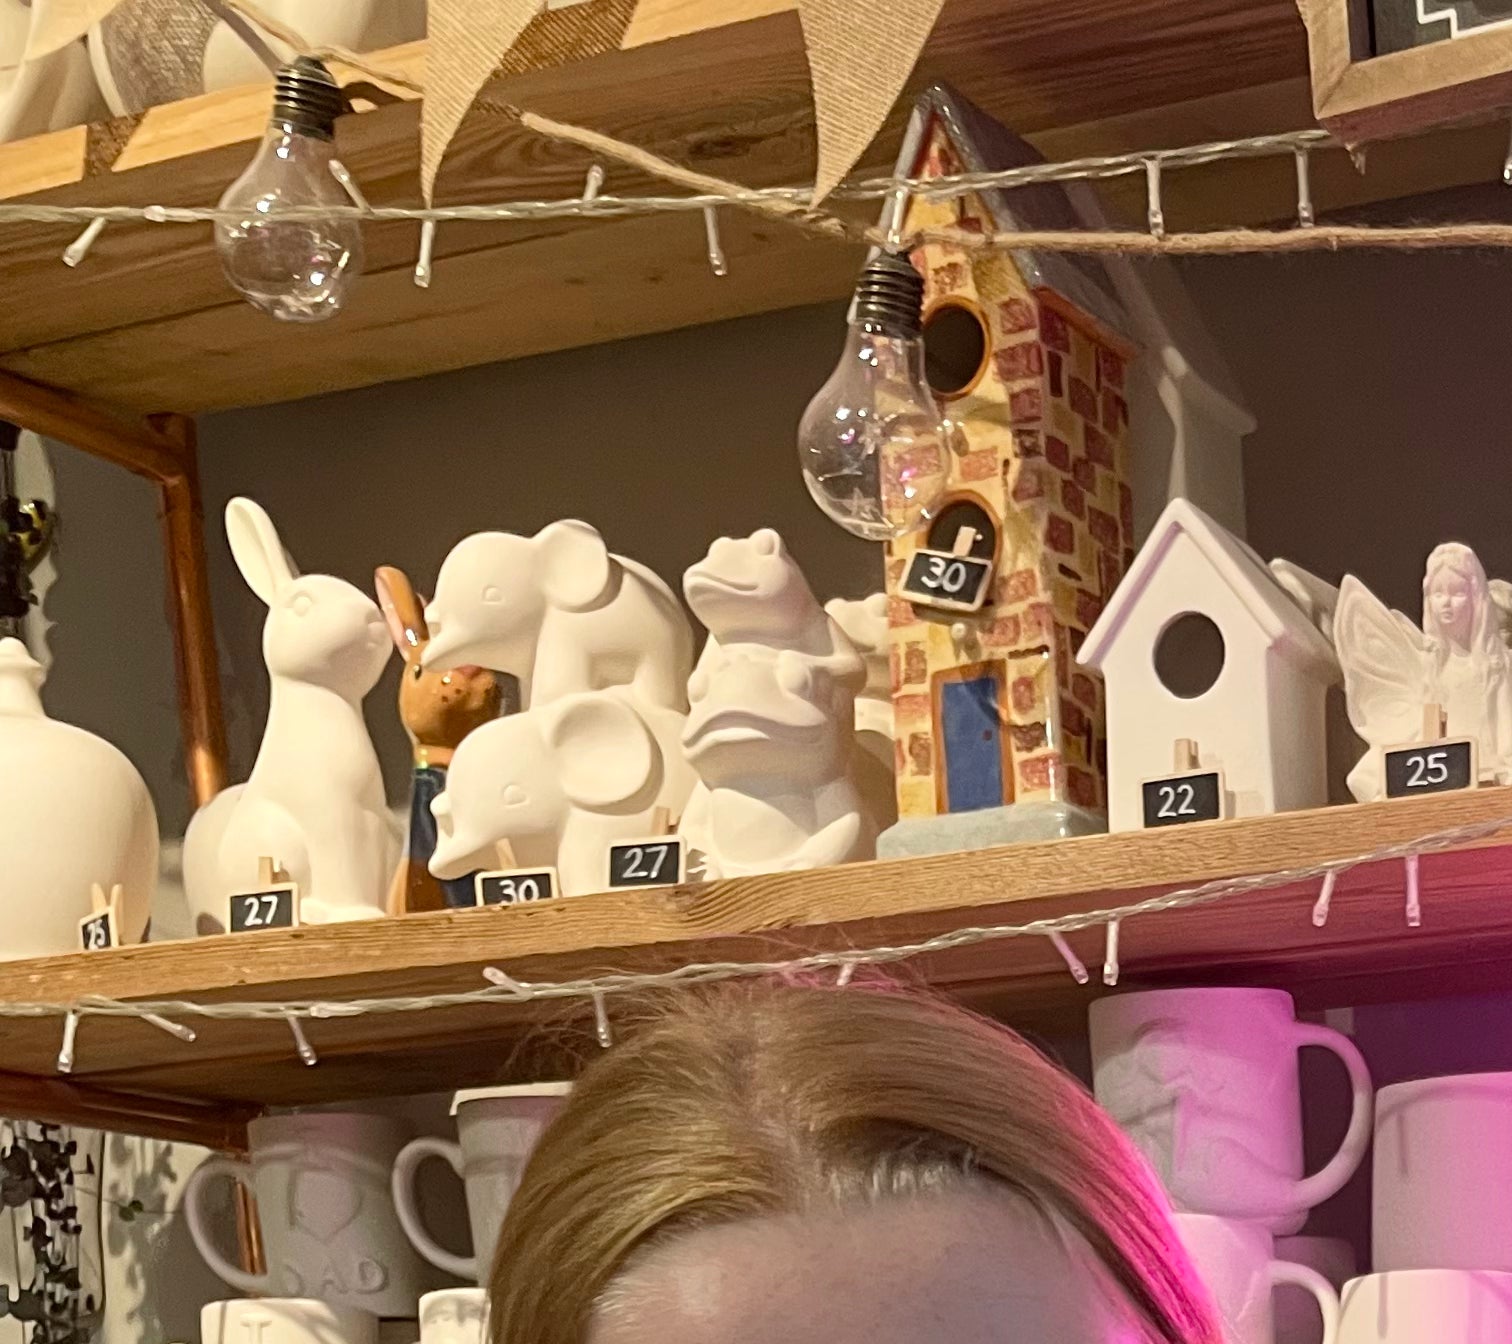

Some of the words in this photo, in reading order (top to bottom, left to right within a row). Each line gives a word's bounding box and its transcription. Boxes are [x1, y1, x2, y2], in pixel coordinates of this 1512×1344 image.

[921, 557, 967, 593] 30
[1405, 752, 1448, 788] 25
[1157, 783, 1197, 818] 22
[621, 845, 668, 879] 27
[499, 877, 540, 906] 30
[243, 895, 279, 927] 27
